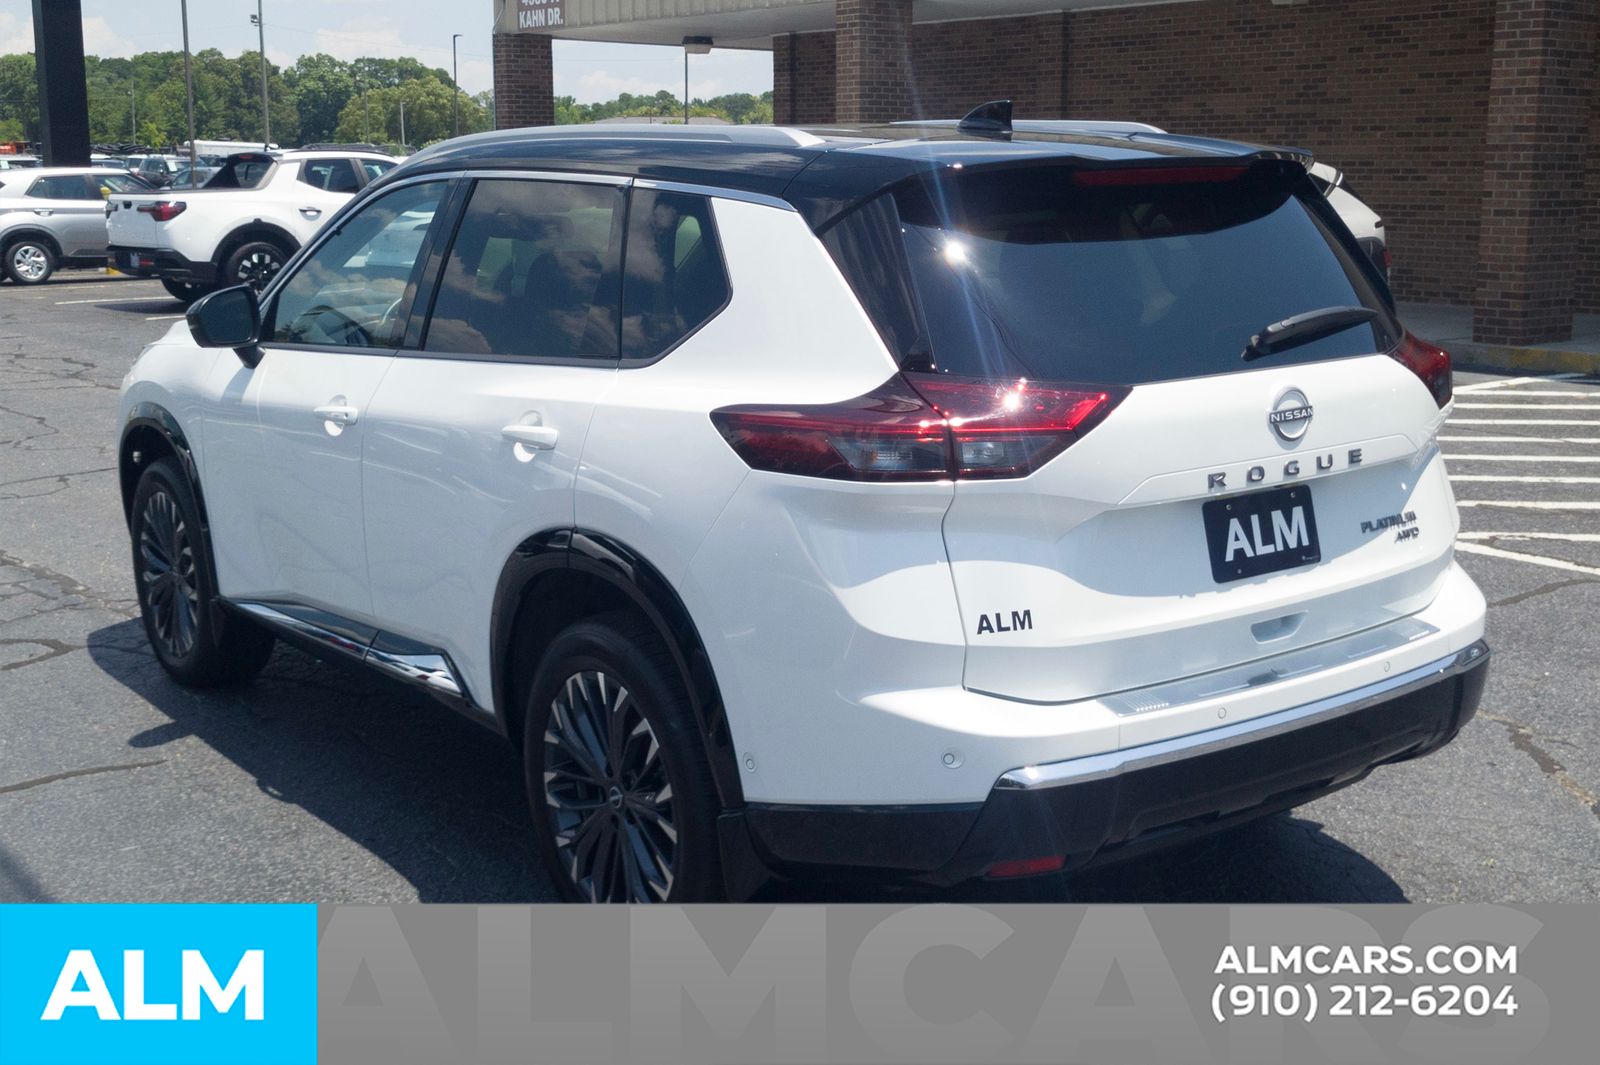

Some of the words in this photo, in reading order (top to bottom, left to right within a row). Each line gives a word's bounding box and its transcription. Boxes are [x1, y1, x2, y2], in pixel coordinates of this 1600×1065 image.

[519, 9, 545, 28] KAHN
[547, 7, 564, 26] DR.
[1270, 407, 1313, 423] NISSAN
[1208, 448, 1362, 489] ROGUE
[1225, 506, 1310, 562] ALM
[976, 609, 1033, 635] ALM
